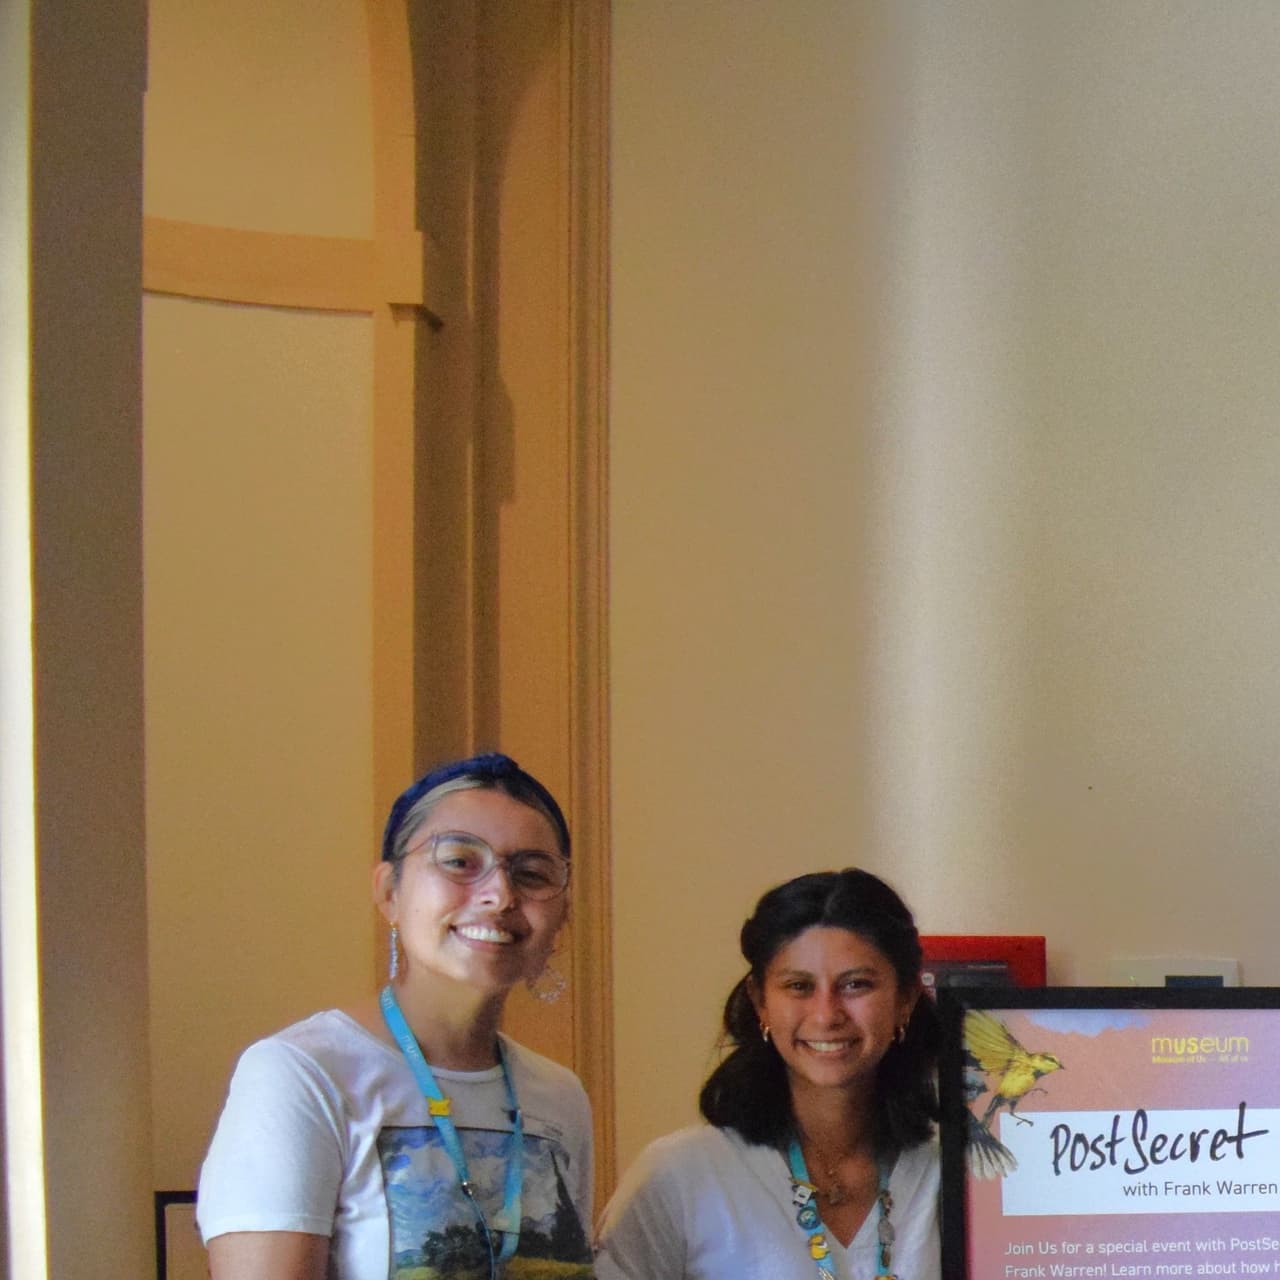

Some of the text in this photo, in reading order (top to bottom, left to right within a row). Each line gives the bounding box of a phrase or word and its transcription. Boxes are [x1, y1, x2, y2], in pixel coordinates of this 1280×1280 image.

[1151, 1036, 1249, 1056] museum
[1049, 1101, 1269, 1176] PostSecret
[1123, 1180, 1278, 1197] with Frank Warren
[1004, 1241, 1034, 1256] Join
[1038, 1241, 1057, 1255] Us
[1062, 1241, 1081, 1254] for
[1086, 1243, 1094, 1254] a
[1098, 1240, 1148, 1257] special
[1152, 1241, 1191, 1253] event
[1196, 1238, 1226, 1252] with
[1005, 1264, 1046, 1278] Frank
[1050, 1263, 1107, 1277] Warren!
[1111, 1263, 1151, 1277] Learn
[1156, 1264, 1193, 1275] more
[1197, 1261, 1237, 1275] about
[1240, 1260, 1271, 1274] how
